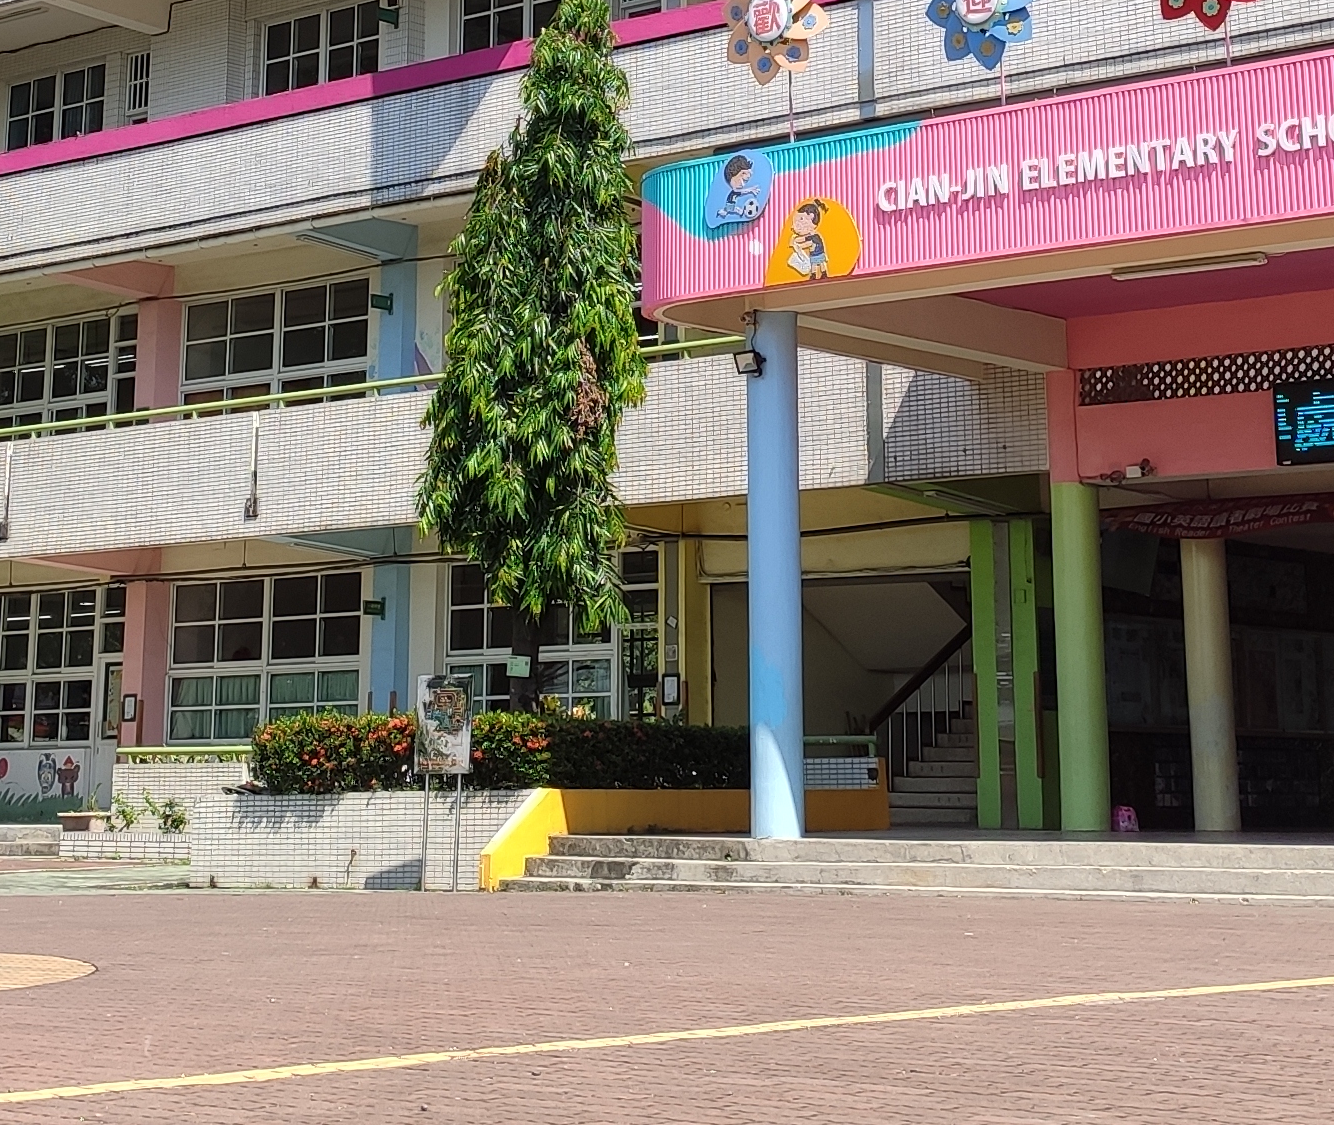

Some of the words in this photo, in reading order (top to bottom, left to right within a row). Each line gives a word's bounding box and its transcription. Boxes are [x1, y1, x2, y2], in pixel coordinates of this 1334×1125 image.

[878, 163, 1010, 213] CIAN-JIN
[1021, 128, 1239, 191] ELEMENTARY
[1229, 521, 1264, 534] Theater
[1270, 513, 1311, 526] Contest
